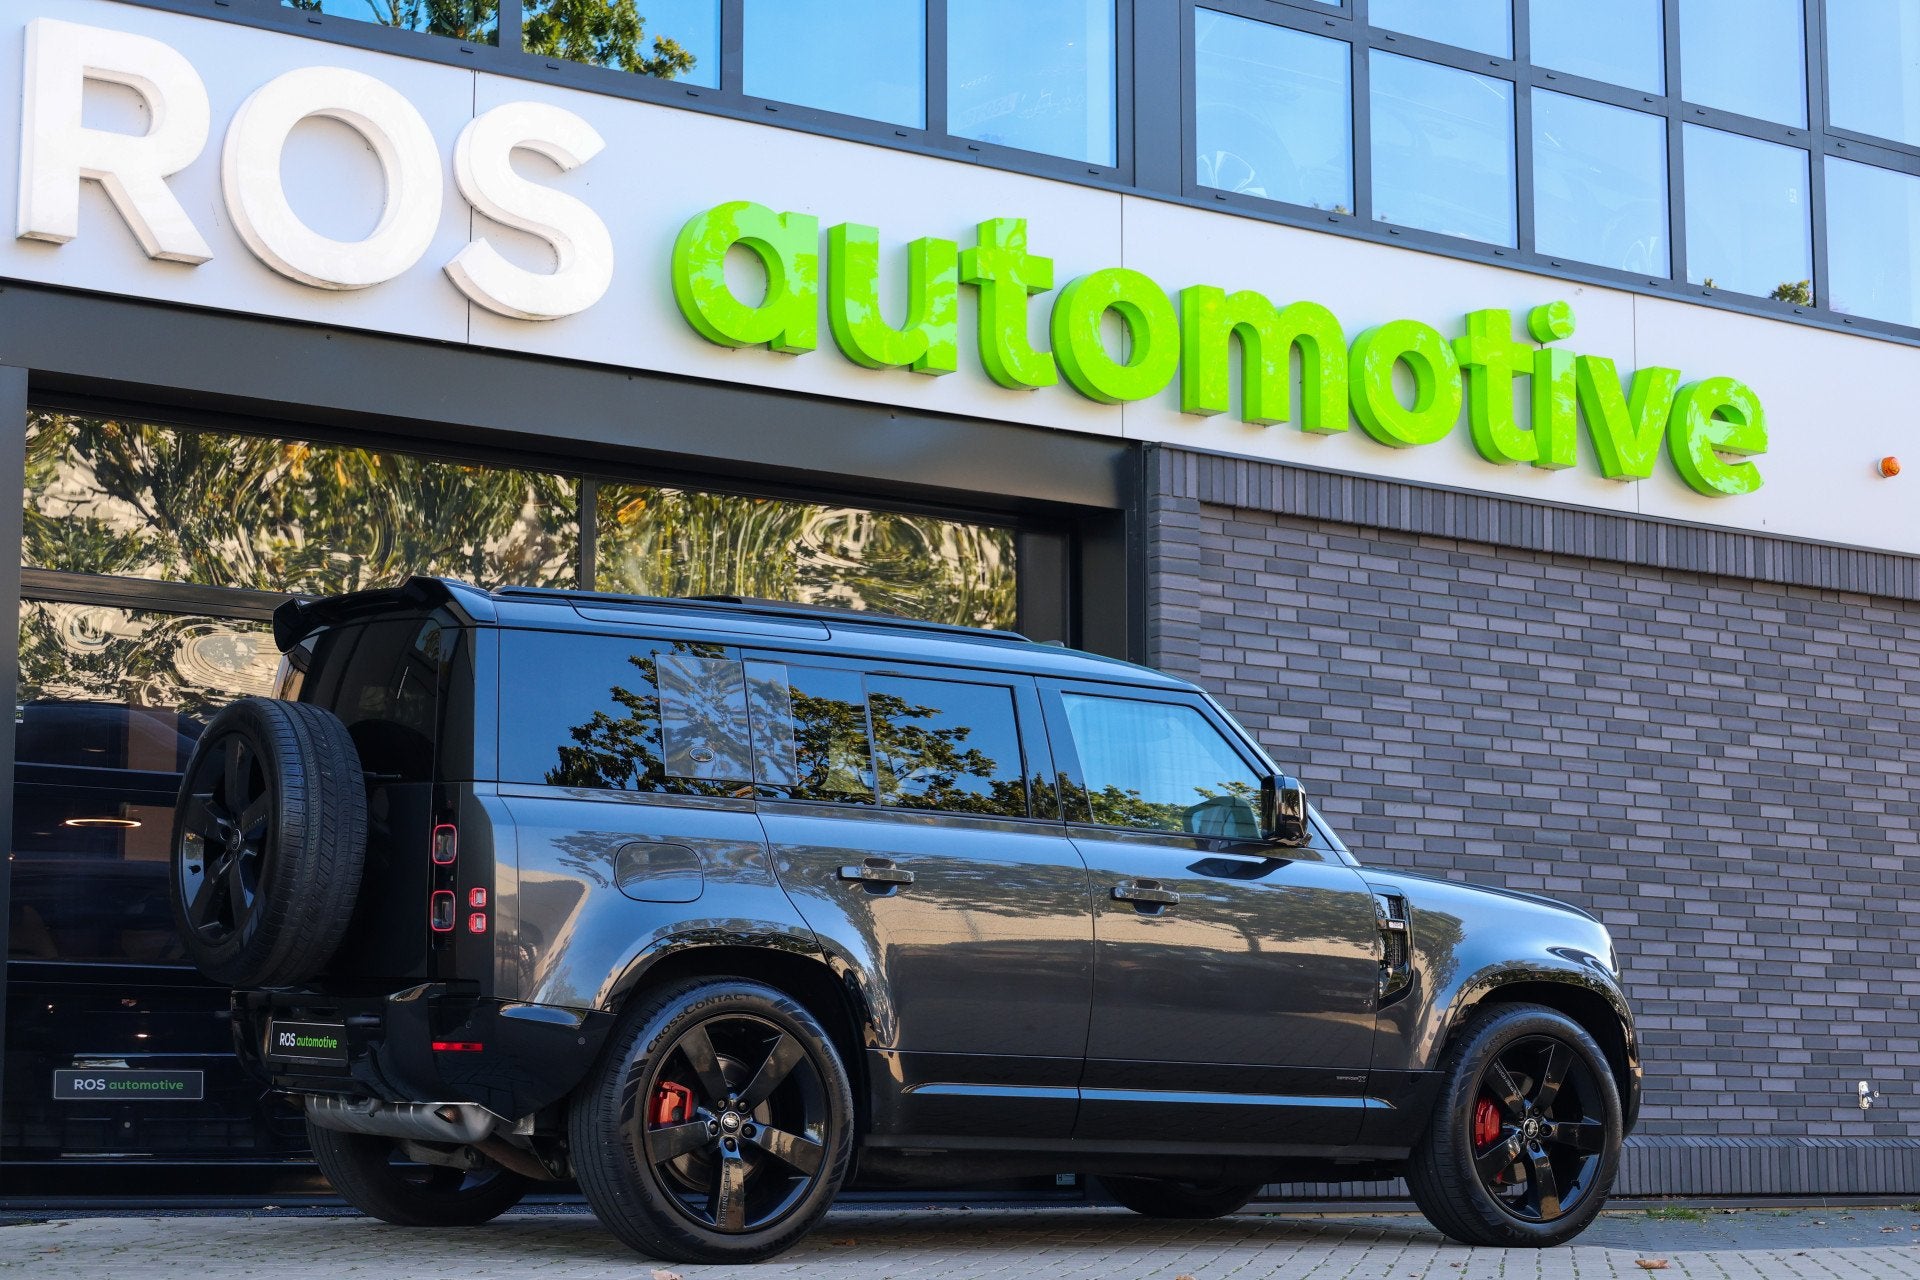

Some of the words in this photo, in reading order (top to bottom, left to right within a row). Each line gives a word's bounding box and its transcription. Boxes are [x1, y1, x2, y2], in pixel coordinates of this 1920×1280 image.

[16, 16, 615, 322] ROS
[671, 200, 1769, 498] automotive
[279, 1032, 296, 1047] ROS
[296, 1035, 338, 1049] automotive
[74, 1078, 106, 1091] ROS
[109, 1079, 184, 1090] automotive
